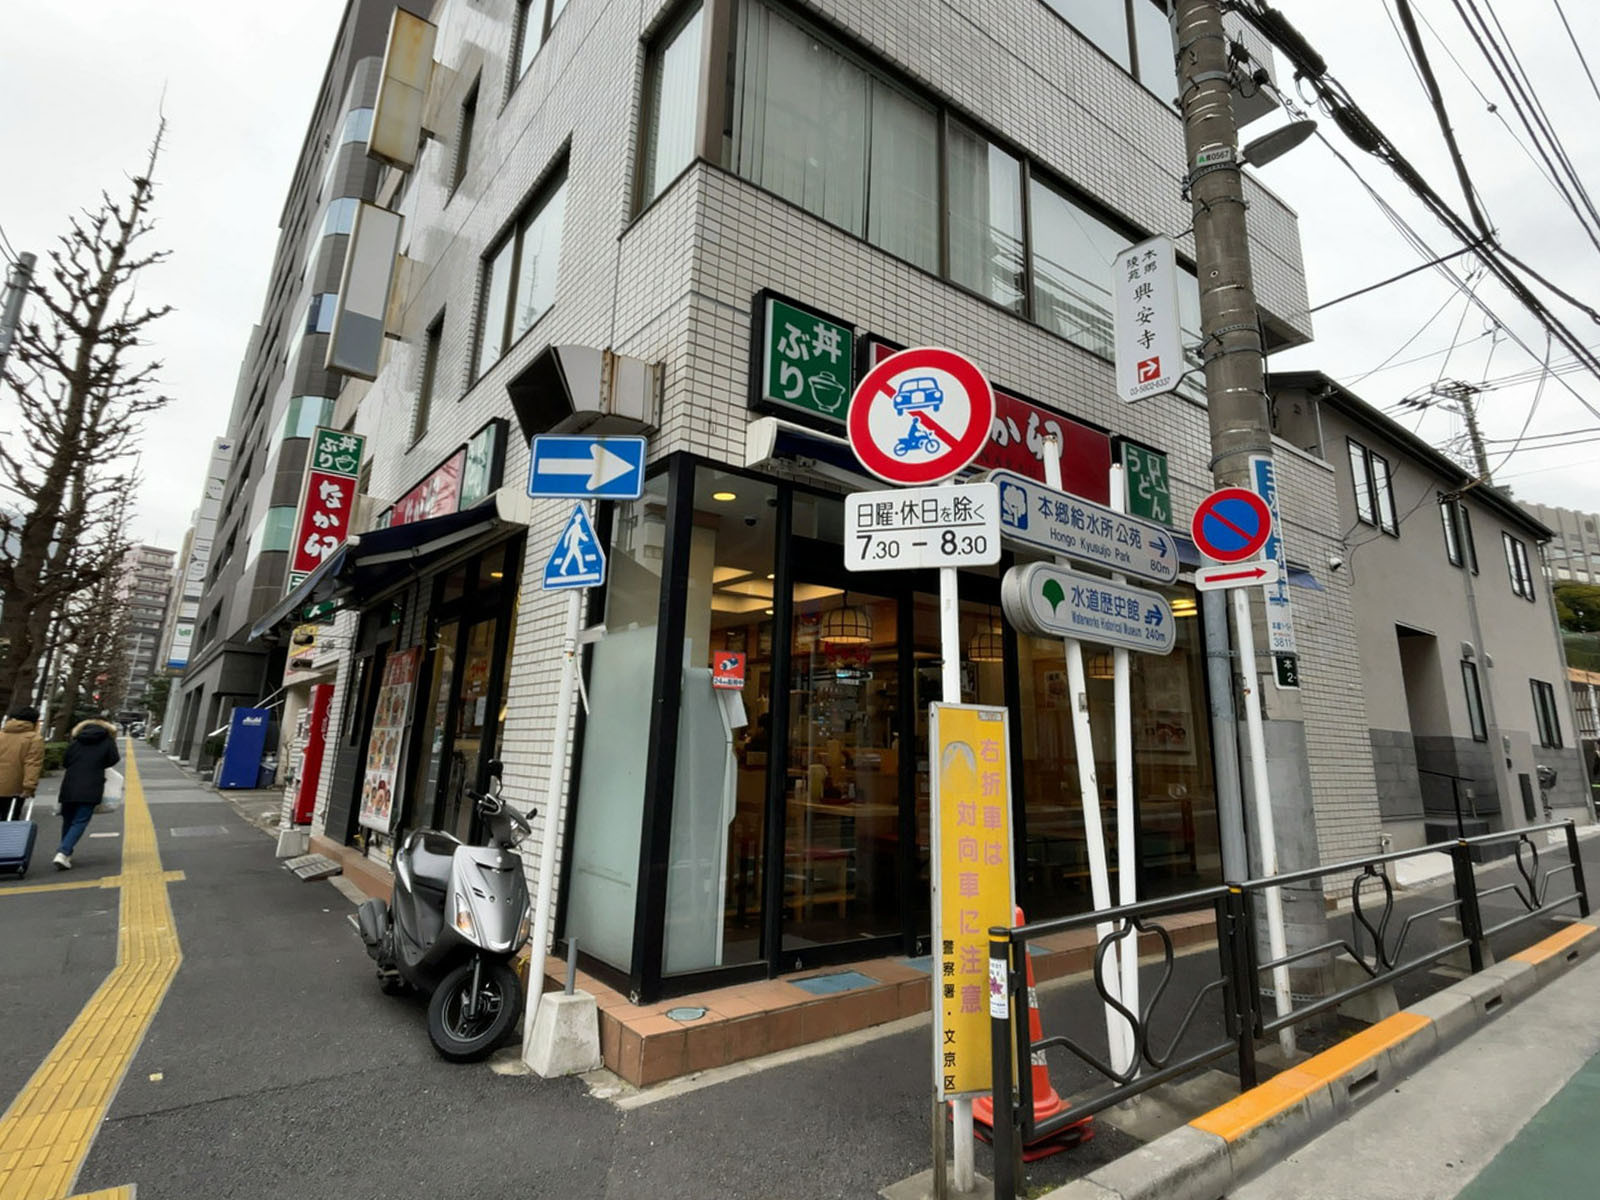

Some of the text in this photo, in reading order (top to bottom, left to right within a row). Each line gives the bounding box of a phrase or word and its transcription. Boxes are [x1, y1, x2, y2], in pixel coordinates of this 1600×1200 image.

[1142, 249, 1157, 275] 本郷
[1133, 282, 1157, 350] 興安寺
[1128, 447, 1167, 521] うどん
[1037, 495, 1142, 550] 本郷給水所公苑
[856, 534, 900, 561] 7.30
[941, 530, 987, 557] 8.30
[1049, 527, 1077, 547] Hongo
[1115, 548, 1131, 564] Park
[1150, 560, 1171, 575] 80m
[1071, 585, 1141, 622] 水道歴史館
[1145, 627, 1166, 642] 240m
[980, 738, 1004, 866] 右折車は
[956, 800, 983, 1014] 対向車に注意
